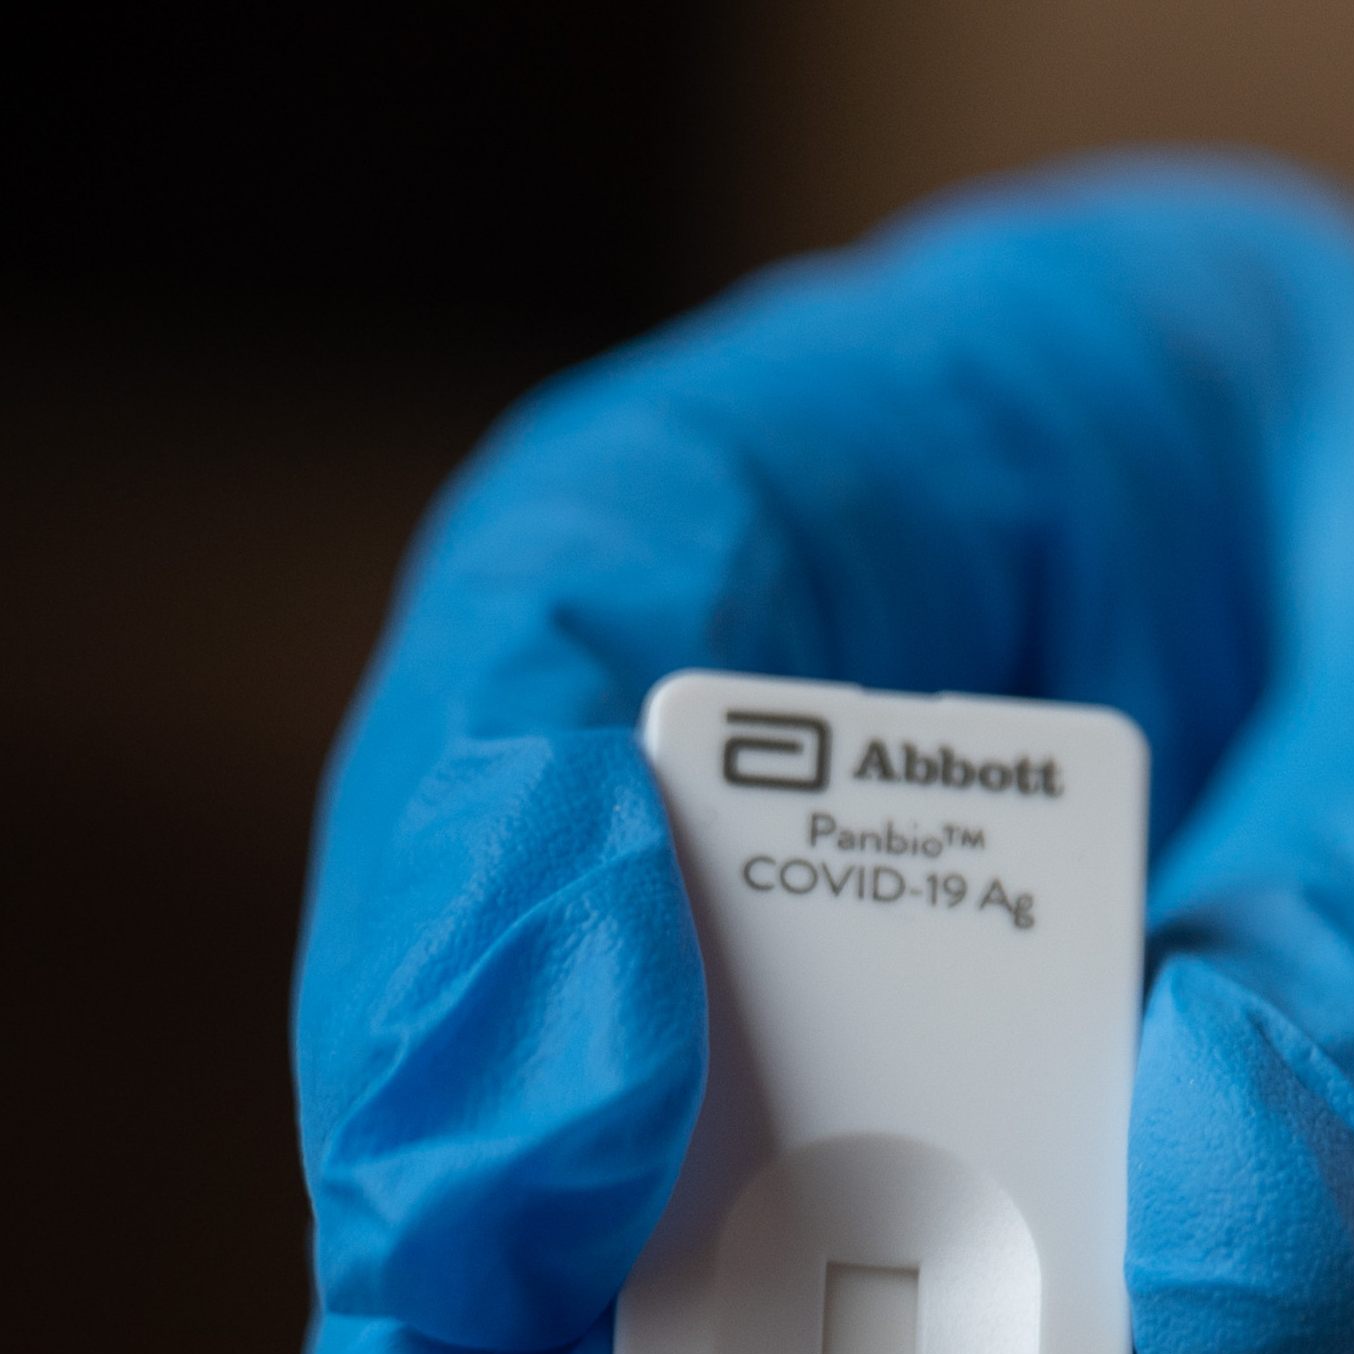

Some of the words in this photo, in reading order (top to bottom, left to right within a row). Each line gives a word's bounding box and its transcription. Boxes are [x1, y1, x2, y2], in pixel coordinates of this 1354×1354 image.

[853, 737, 1063, 798] Abbott
[742, 855, 967, 908] COVID-19
[979, 878, 1036, 930] Ag
